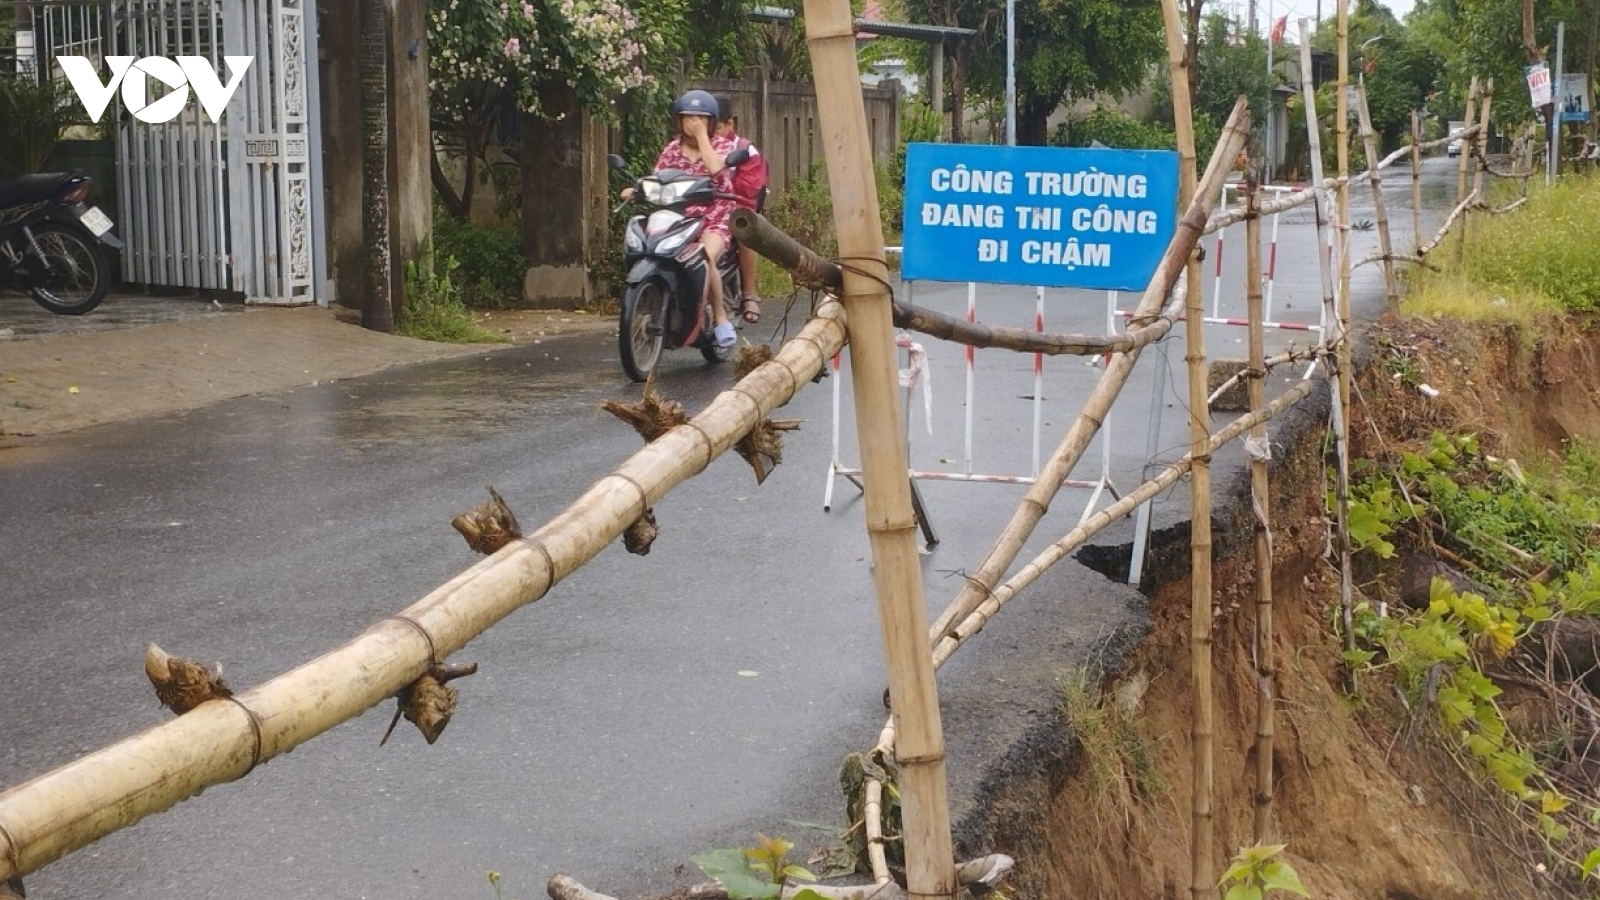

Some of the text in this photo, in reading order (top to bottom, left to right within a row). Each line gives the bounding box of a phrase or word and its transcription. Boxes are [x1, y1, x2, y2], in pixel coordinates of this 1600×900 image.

[931, 164, 1148, 198] CÔNG TRƯỜNG
[921, 203, 1158, 234] ĐANG THI CÔNG
[978, 237, 1111, 271] ĐI CHẬM
